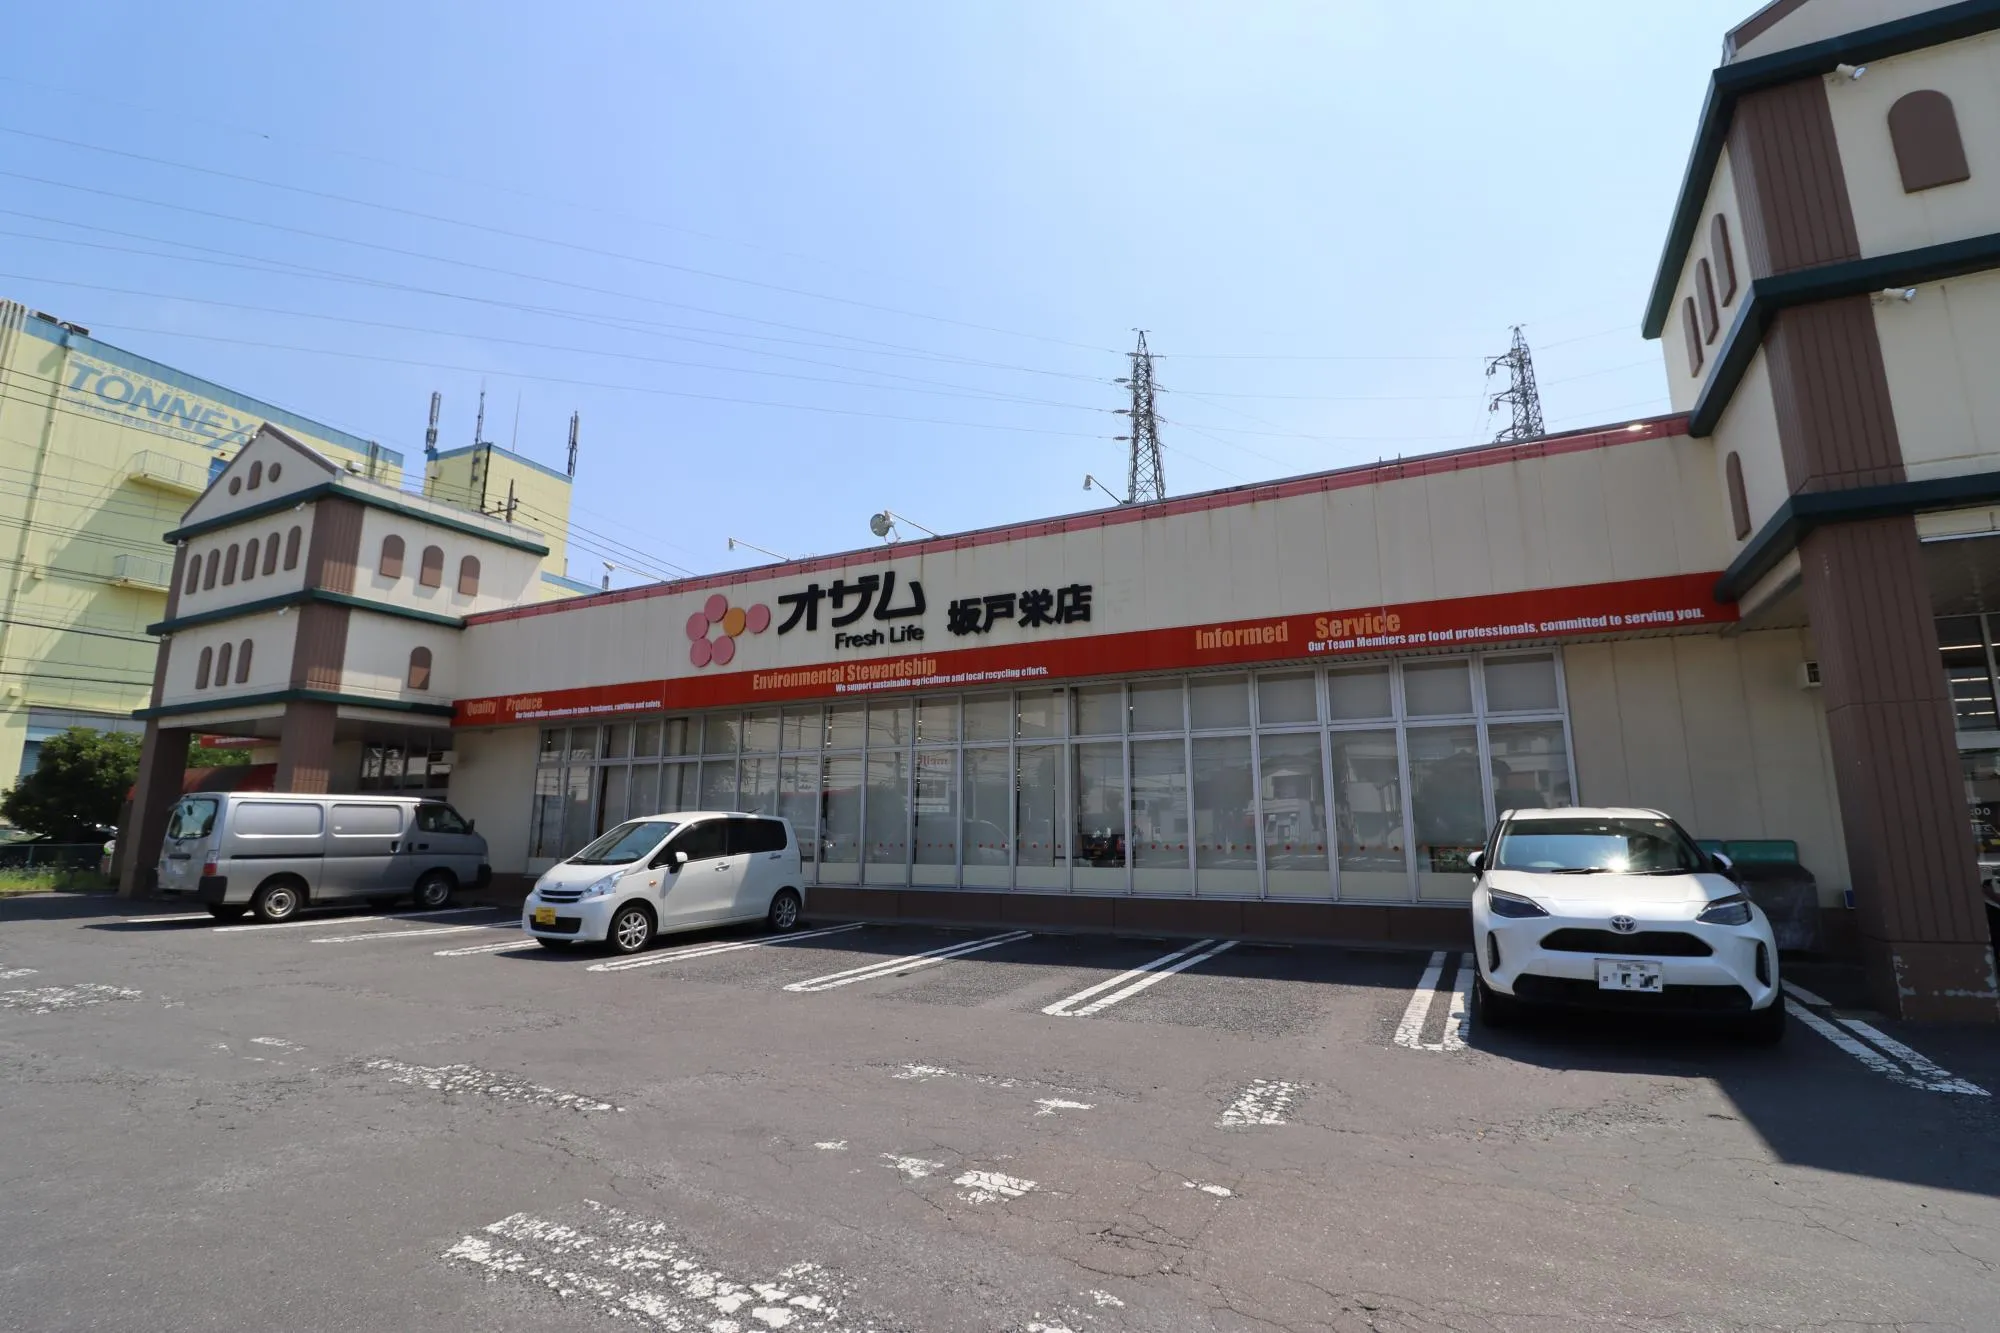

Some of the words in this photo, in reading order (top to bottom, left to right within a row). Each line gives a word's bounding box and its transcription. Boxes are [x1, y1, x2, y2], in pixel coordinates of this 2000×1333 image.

[68, 360, 257, 450] TONNEX
[777, 571, 926, 635] オザム
[947, 583, 1093, 636] 坂戸栄店
[834, 629, 885, 650] Fresh
[889, 624, 925, 644] Life
[1196, 621, 1289, 650] Informed
[1315, 613, 1400, 639] Service
[1308, 640, 1325, 652] Our
[1327, 638, 1355, 650] Team
[1357, 634, 1406, 648] Members
[1408, 633, 1426, 643] are
[1428, 629, 1453, 642] food
[1455, 622, 1538, 641] professionals,
[1540, 615, 1607, 632] committed
[1609, 615, 1622, 626] to
[1625, 609, 1674, 625] serving
[1676, 607, 1704, 621] you.
[753, 665, 844, 691] Environmental
[847, 657, 937, 682] Stewardship
[835, 683, 846, 693] We
[847, 681, 872, 692] support
[872, 677, 911, 689] sustainable
[912, 674, 951, 687] agriculture
[951, 672, 965, 683] and
[966, 671, 984, 681] local
[985, 668, 1020, 680] recycling
[1021, 666, 1049, 676] efforts.
[467, 700, 497, 717] Quality
[506, 697, 543, 712] Produce
